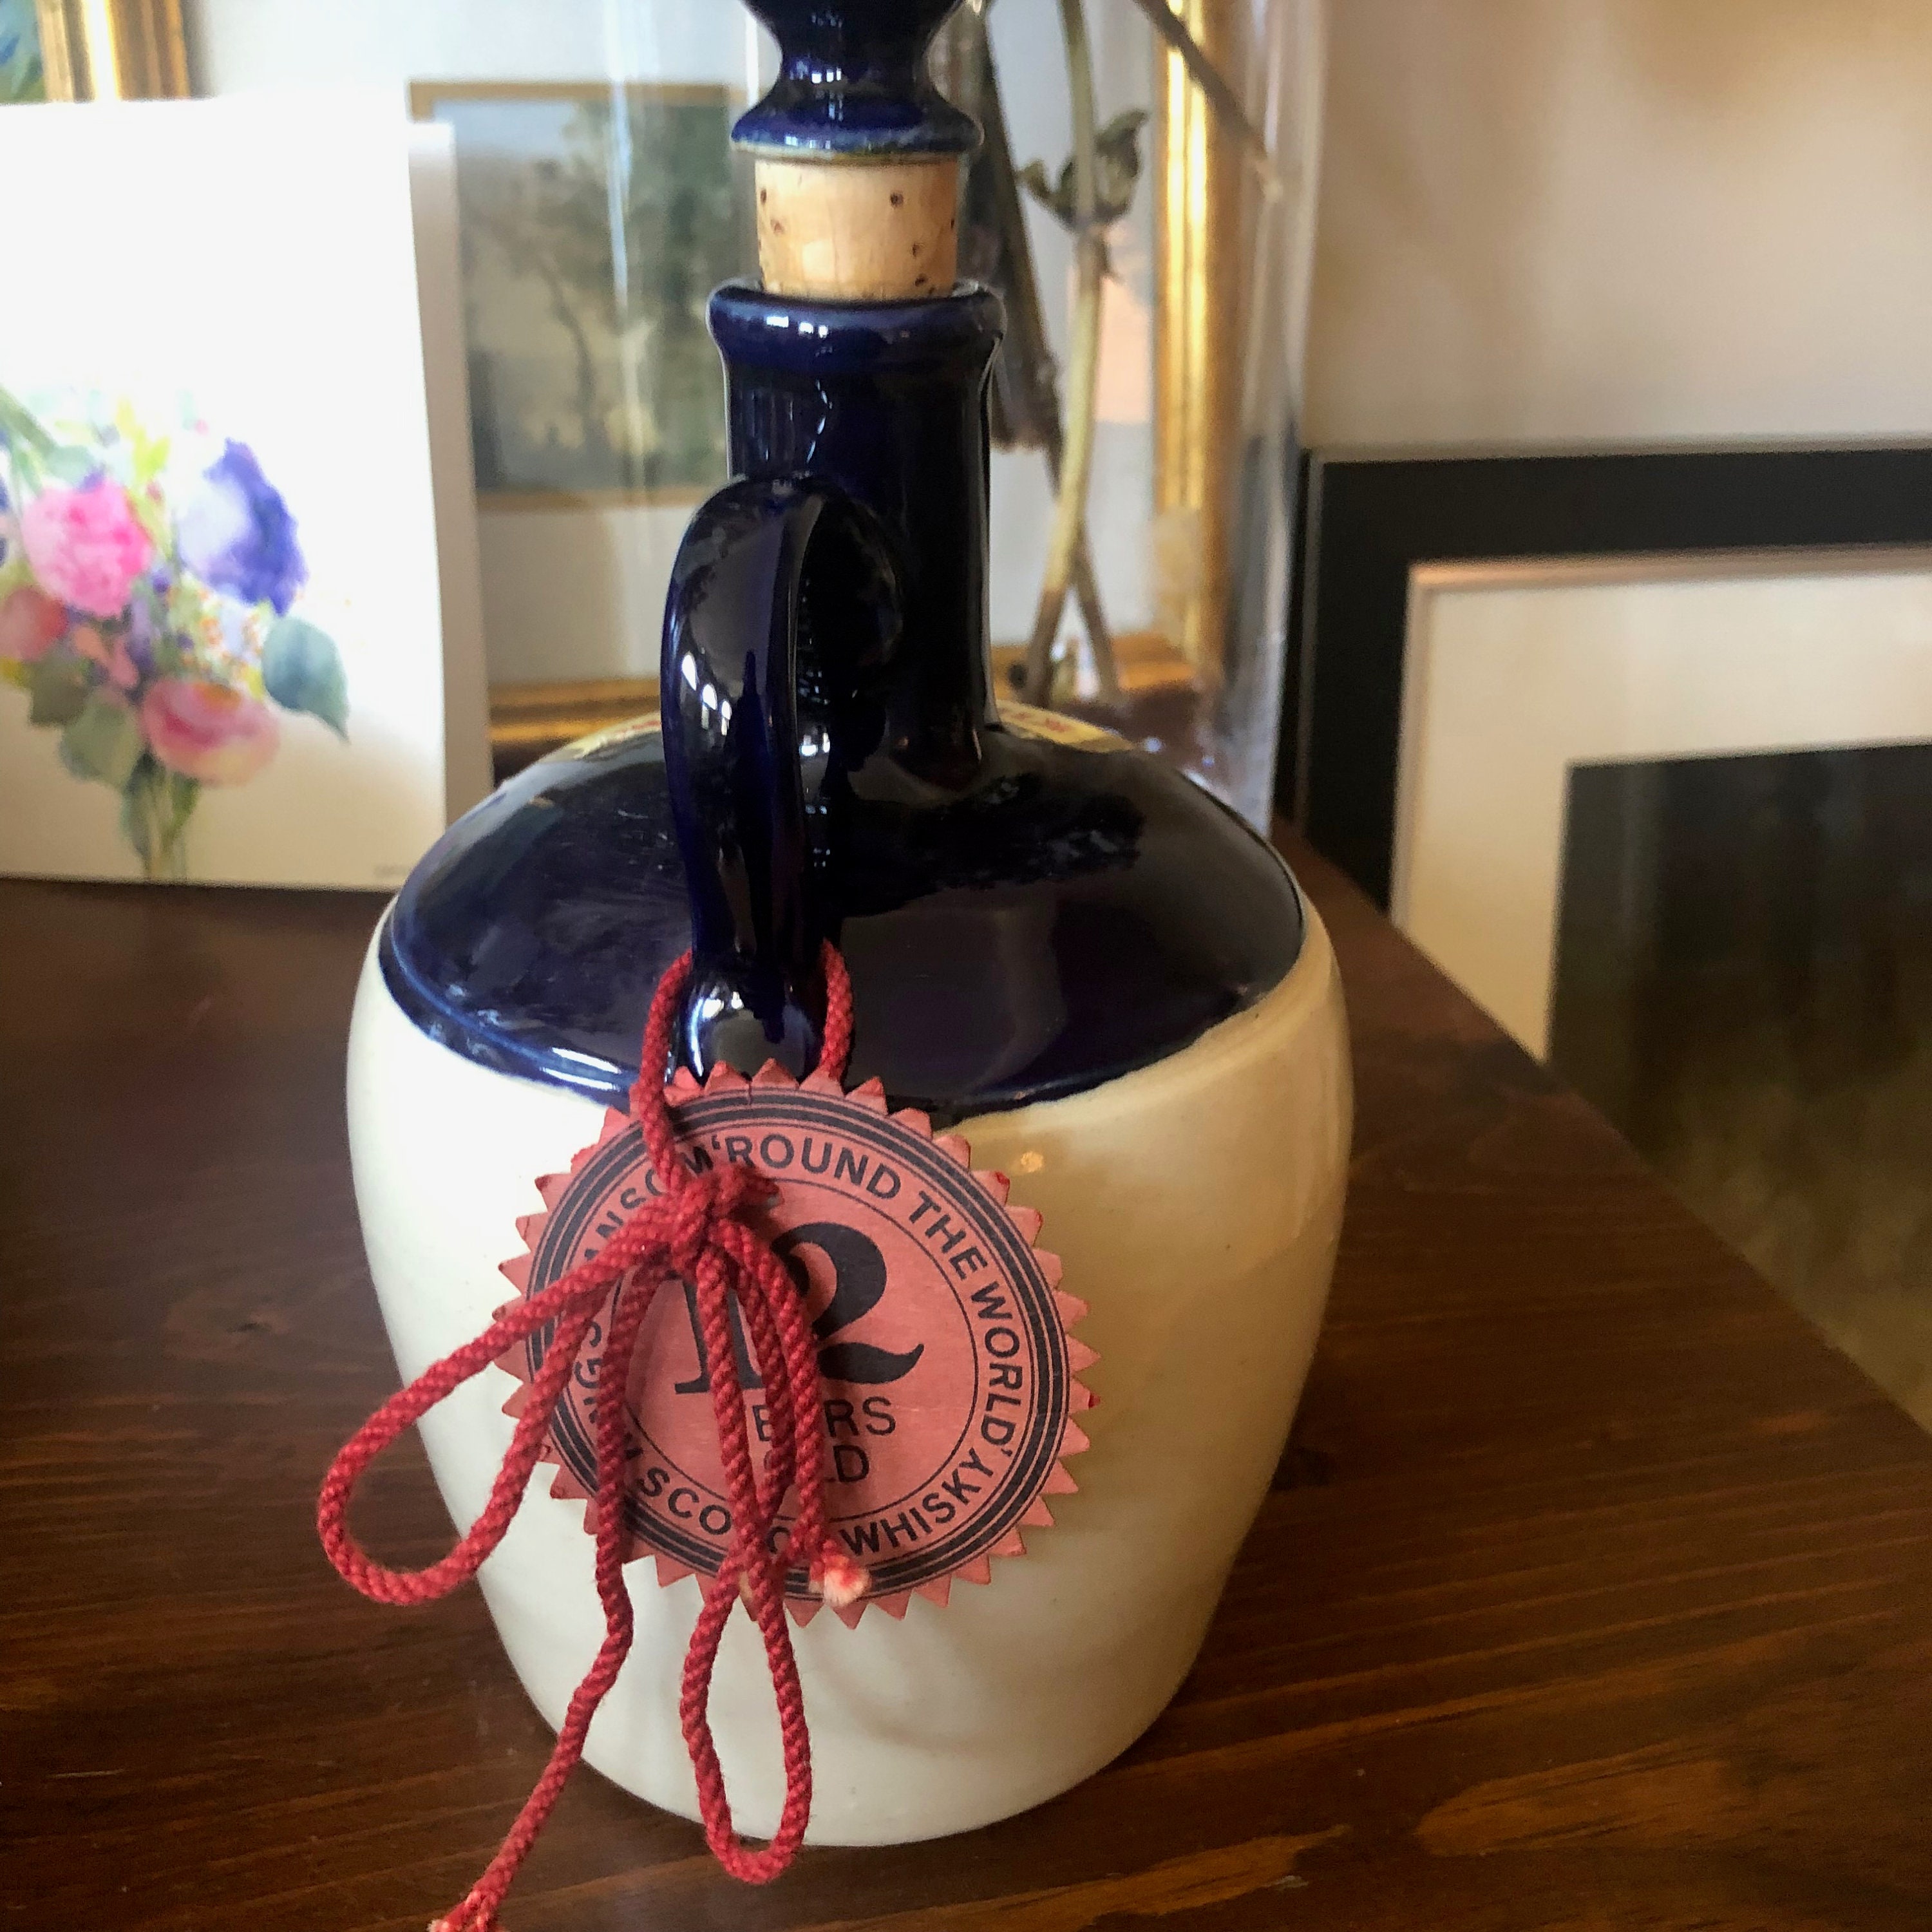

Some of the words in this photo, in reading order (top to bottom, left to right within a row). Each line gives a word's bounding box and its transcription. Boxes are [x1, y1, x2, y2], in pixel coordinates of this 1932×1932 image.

[674, 1222, 925, 1395] 12
[909, 1191, 988, 1280] THE
[970, 1283, 1023, 1457] WORLD'
[752, 1396, 896, 1443] ERS
[639, 1467, 791, 1554] SCOC
[840, 1447, 994, 1556] WHISKY
